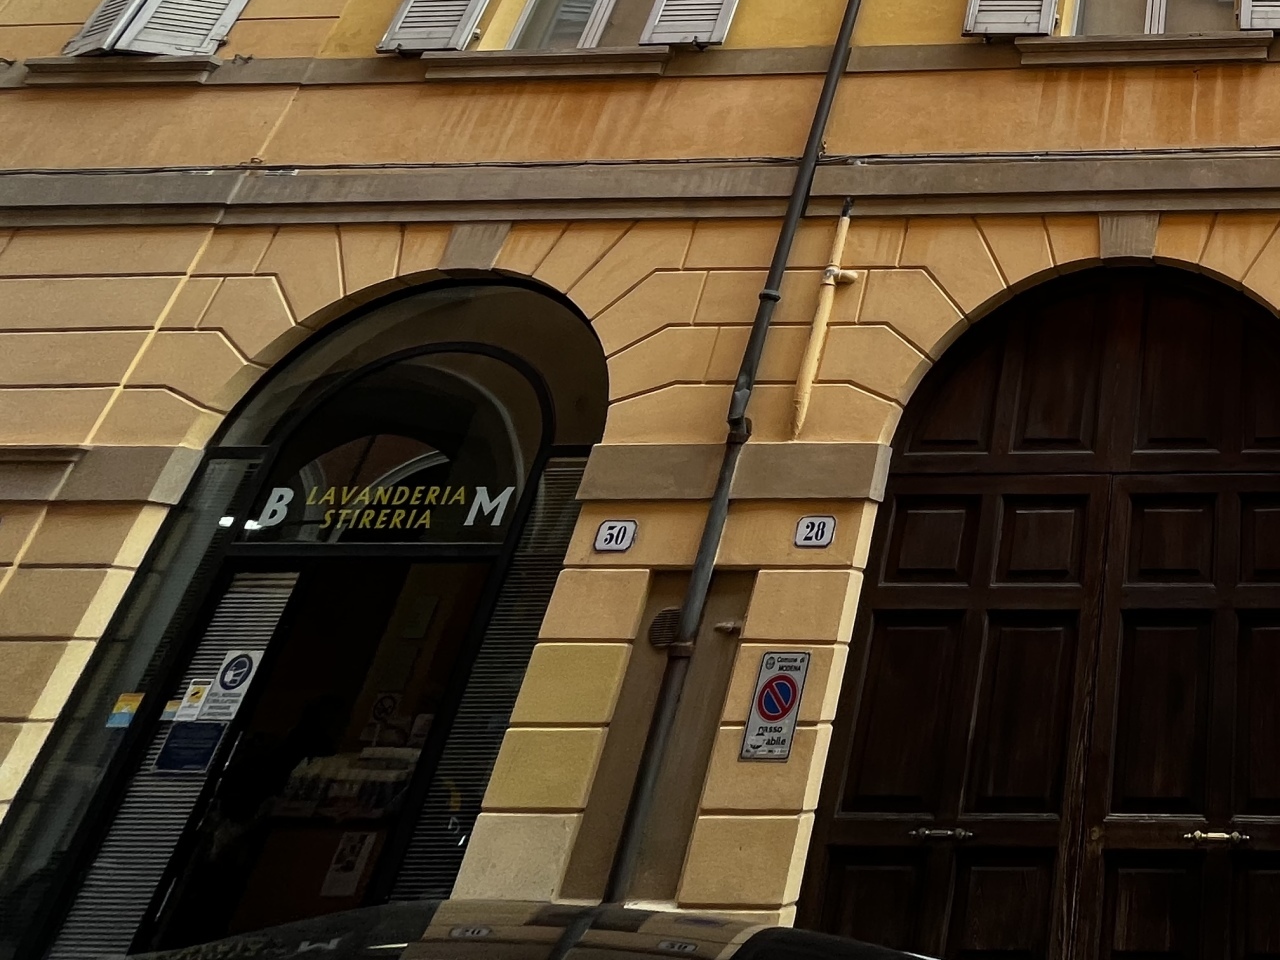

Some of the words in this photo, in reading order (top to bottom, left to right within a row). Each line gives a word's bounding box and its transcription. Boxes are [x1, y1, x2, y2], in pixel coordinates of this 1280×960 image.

[305, 485, 466, 506] LAVANDERIA
[463, 486, 516, 526] M
[257, 487, 295, 527] B
[319, 508, 431, 529] STIRERIA
[803, 521, 826, 541] 28
